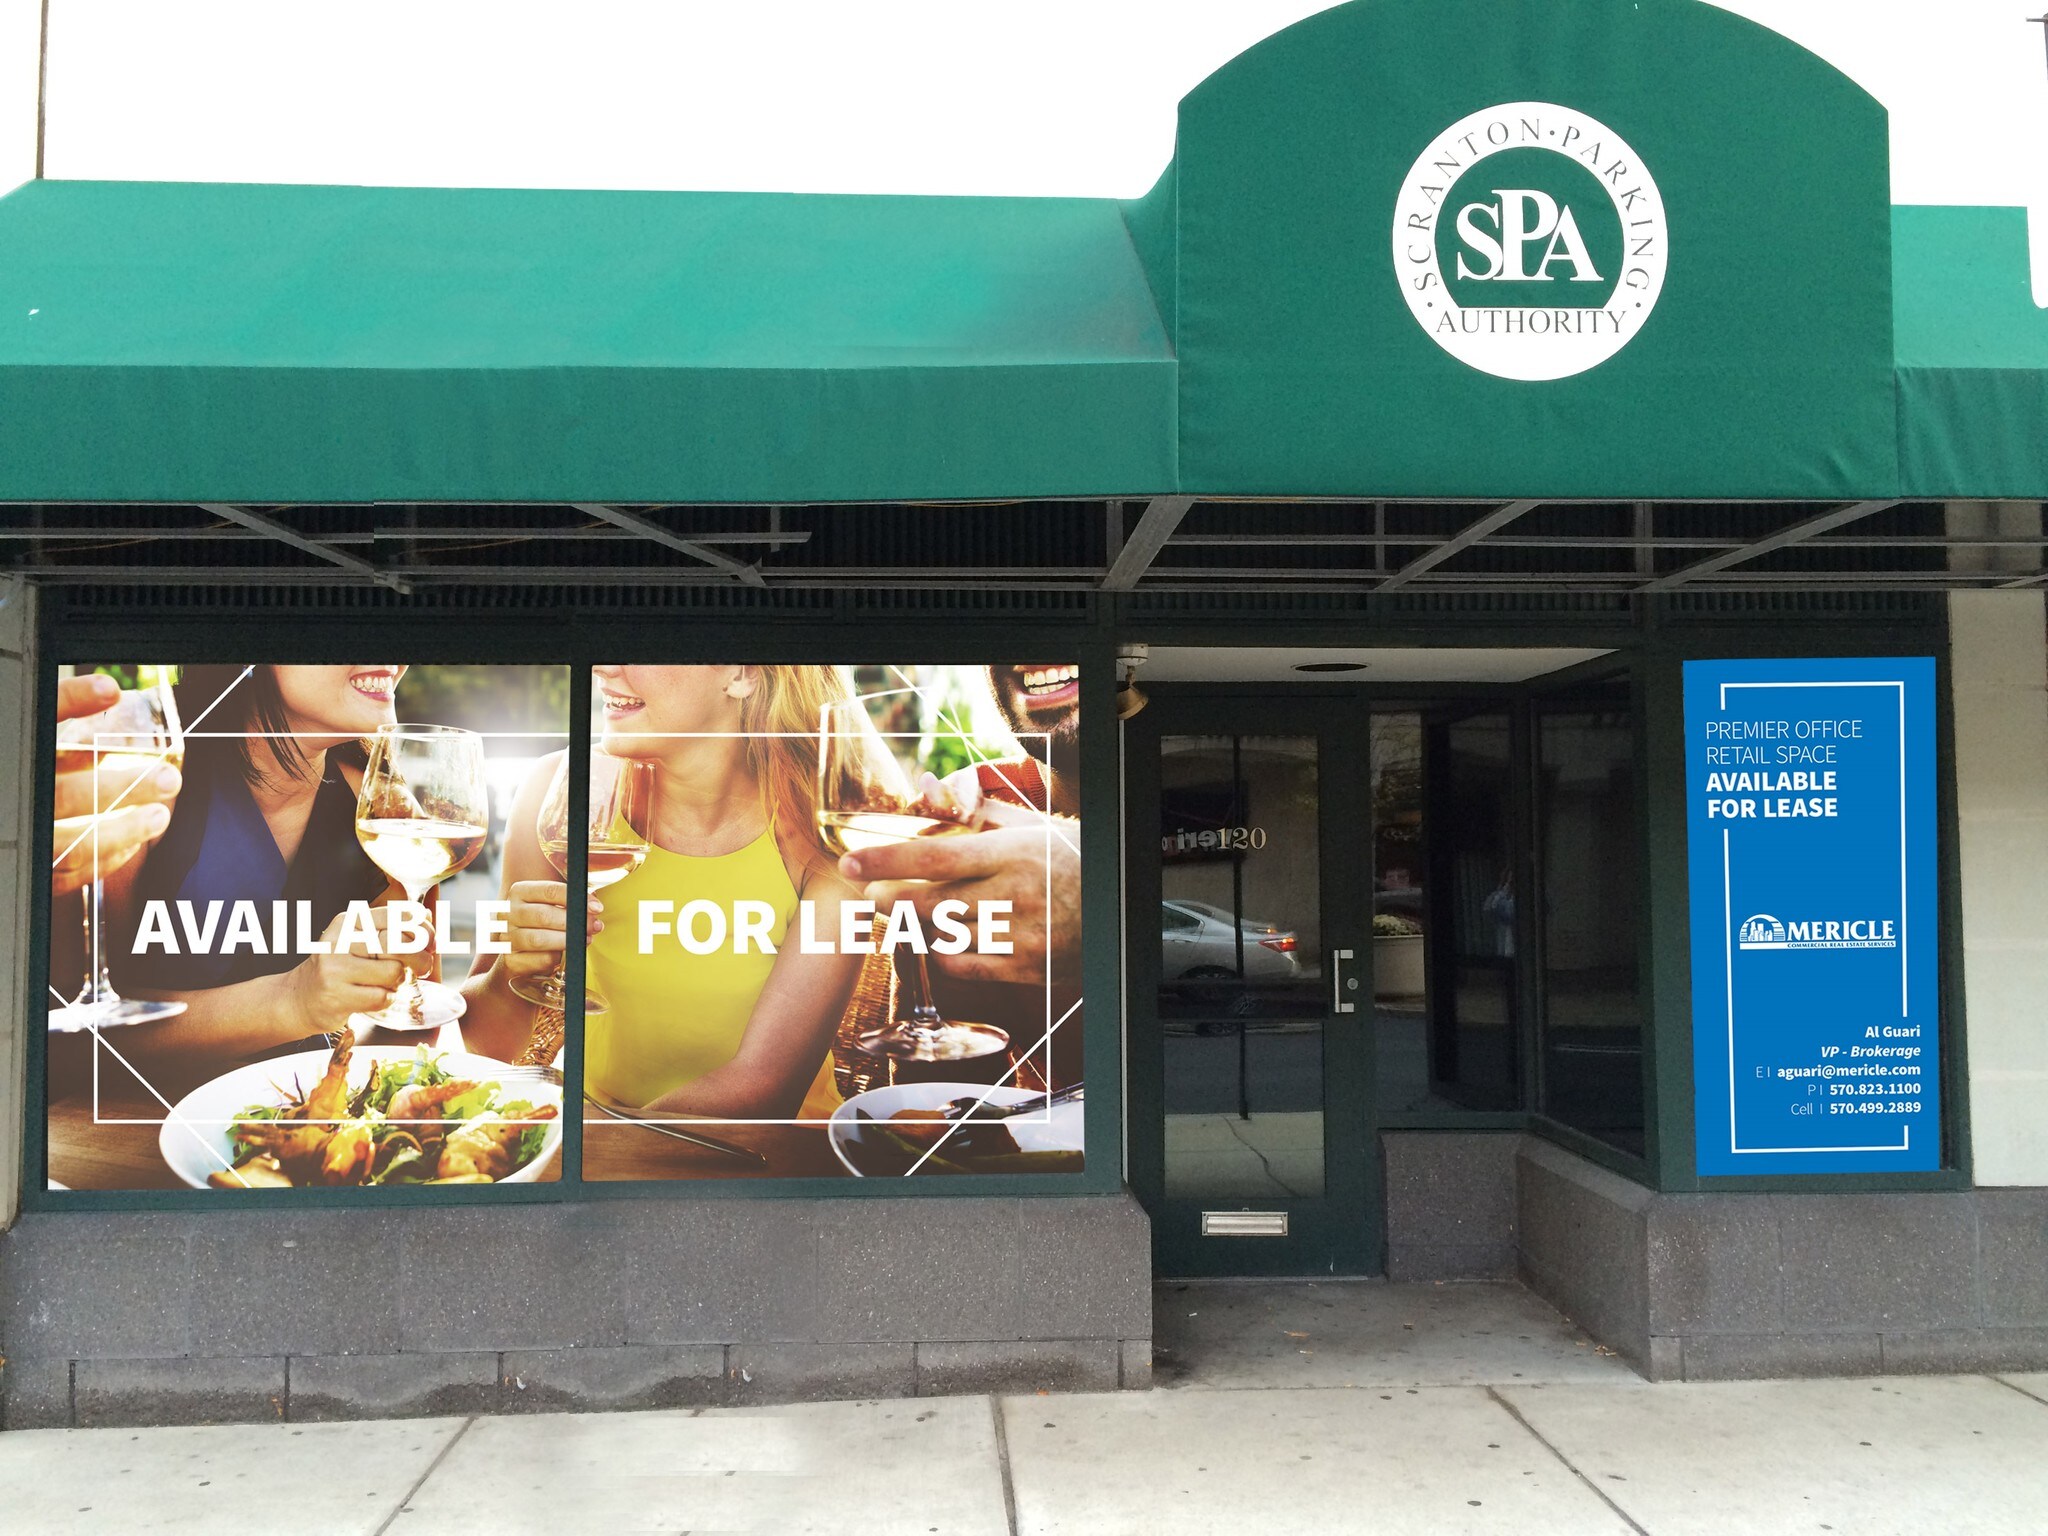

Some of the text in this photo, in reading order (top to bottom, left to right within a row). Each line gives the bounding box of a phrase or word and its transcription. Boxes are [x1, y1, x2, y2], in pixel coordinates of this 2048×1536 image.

[1407, 118, 1654, 291] SCRANTON PARKING
[1456, 189, 1604, 281] SPA
[1436, 310, 1627, 334] AUTHORITY
[1706, 720, 1863, 739] PREMIER OFFICE
[1706, 745, 1837, 765] RETAIL SPACE
[1705, 771, 1838, 792] AVAILABLE
[1708, 797, 1838, 819] FOR LEASE
[1217, 827, 1267, 850] 120
[131, 900, 511, 954] AVAILABLE
[637, 899, 1014, 955] FOR LEASE
[1787, 920, 1896, 941] MERICLE
[1865, 1025, 1921, 1038] Al Guari
[1821, 1046, 1840, 1058] VP
[1850, 1045, 1921, 1060] Brokerage
[1777, 1063, 1921, 1081] aguari@mericle.com
[1829, 1083, 1921, 1096] 570.823.1100
[1790, 1103, 1813, 1115] Cell
[1829, 1101, 1922, 1115] 570.499.2889
